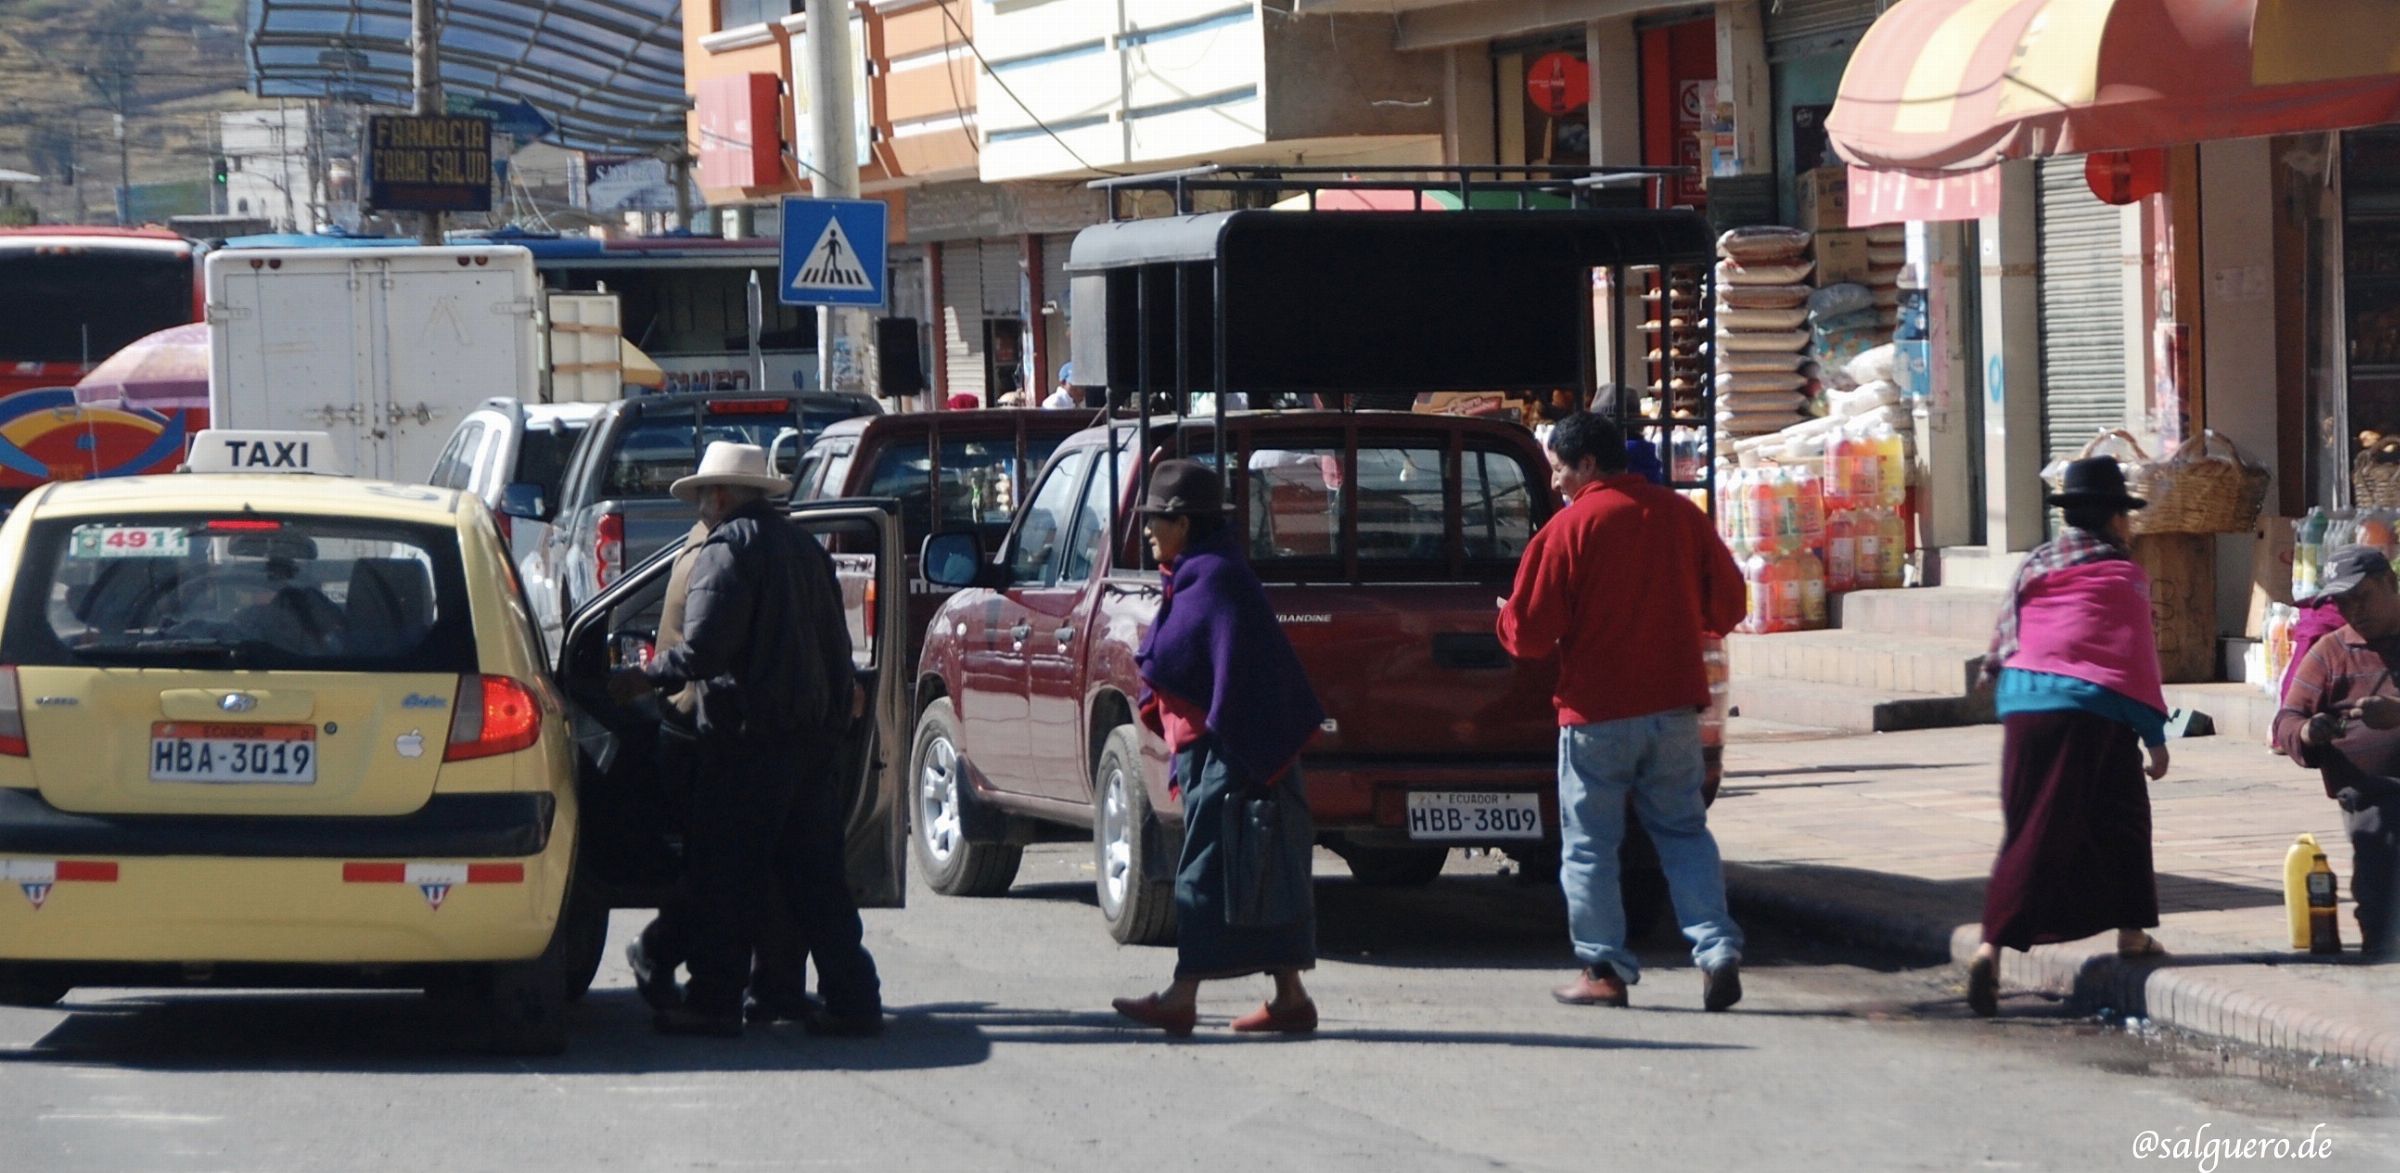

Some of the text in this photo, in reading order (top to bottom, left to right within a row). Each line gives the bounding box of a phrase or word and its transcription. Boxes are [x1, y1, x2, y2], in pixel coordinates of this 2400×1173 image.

[376, 119, 485, 147] FARMACIA
[374, 150, 487, 184] FARMA SALUD
[224, 440, 309, 467] TAXI
[204, 726, 265, 739] ECUADOR
[155, 742, 310, 774] HBA-3019
[1448, 793, 1499, 804] ECUADOR
[1411, 808, 1537, 832] HBB-3809
